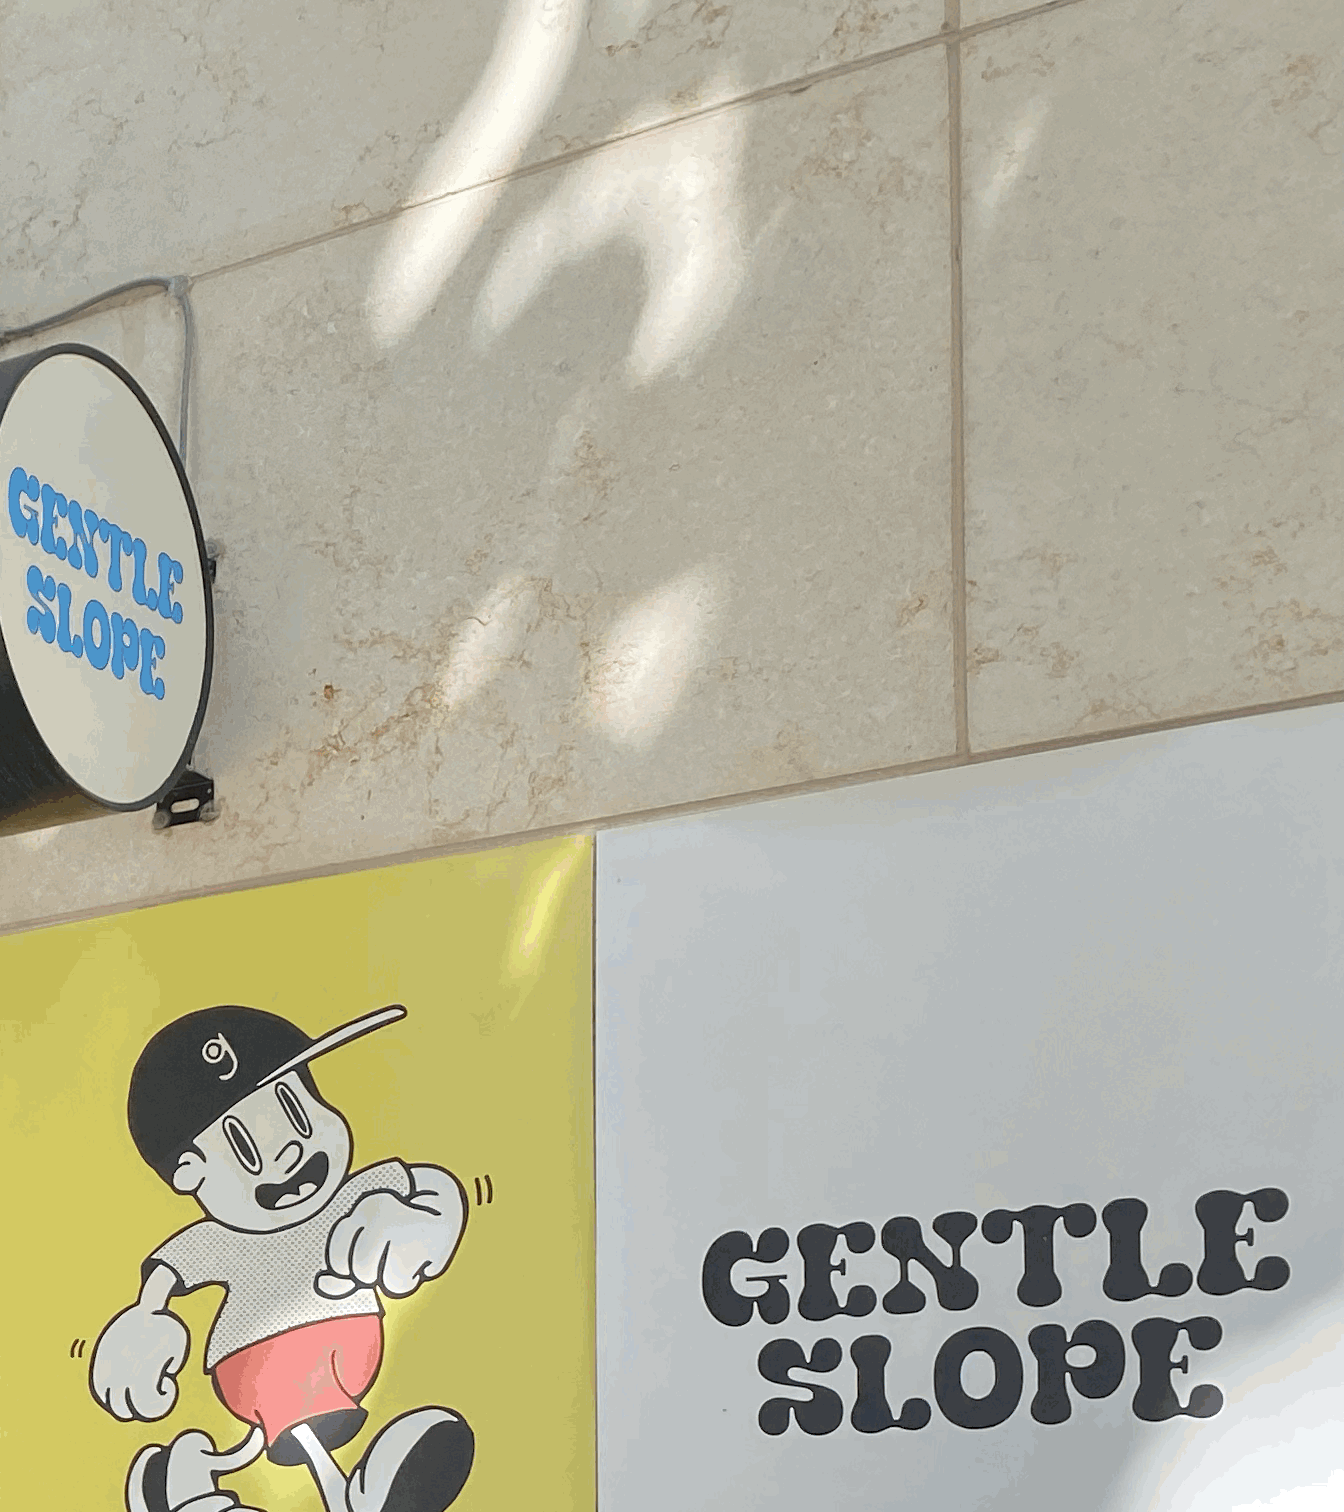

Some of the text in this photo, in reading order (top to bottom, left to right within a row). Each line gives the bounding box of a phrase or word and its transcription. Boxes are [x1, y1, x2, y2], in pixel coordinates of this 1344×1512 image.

[8, 467, 183, 624] GENTLE
[27, 565, 165, 700] SLOPE
[702, 1188, 1290, 1326] GENTLE
[758, 1316, 1223, 1435] SLOPE
